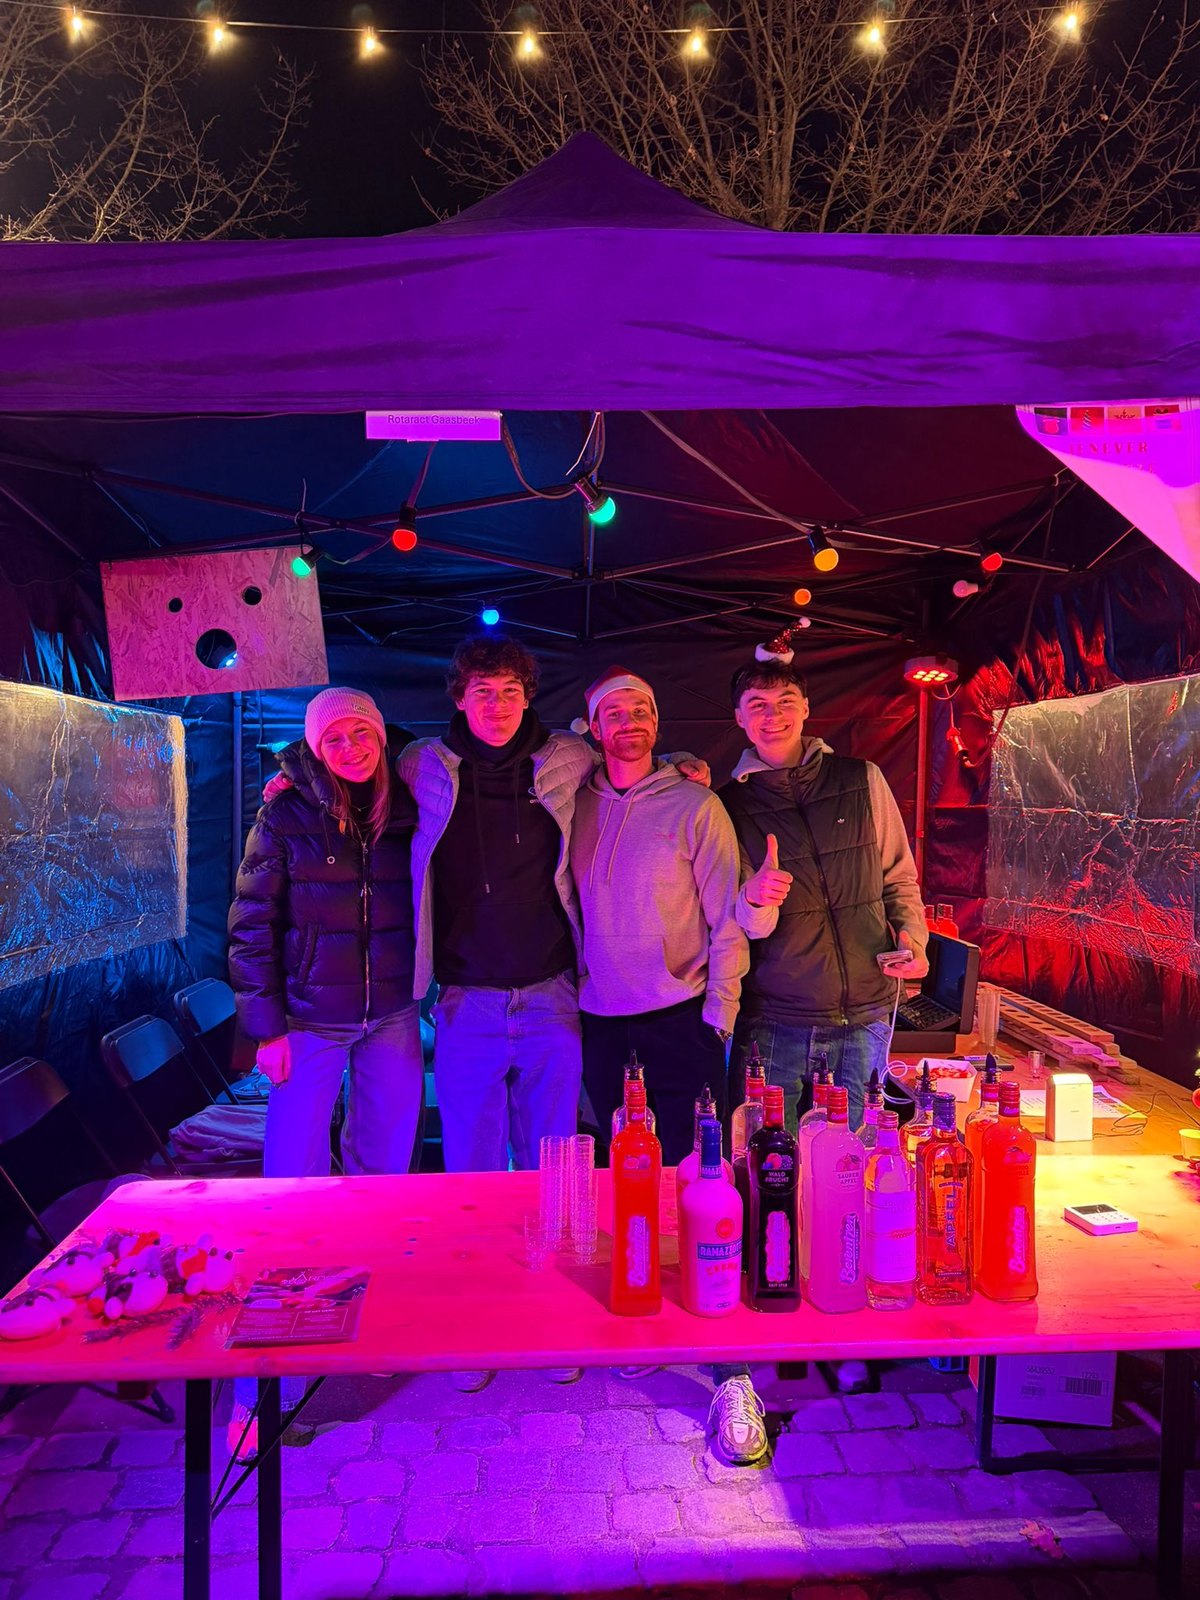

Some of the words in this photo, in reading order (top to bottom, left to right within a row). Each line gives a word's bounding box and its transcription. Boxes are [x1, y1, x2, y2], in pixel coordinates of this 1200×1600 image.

[387, 414, 429, 425] Rotaract
[431, 414, 481, 425] Gaasbeek
[946, 1187, 957, 1247] APFEL
